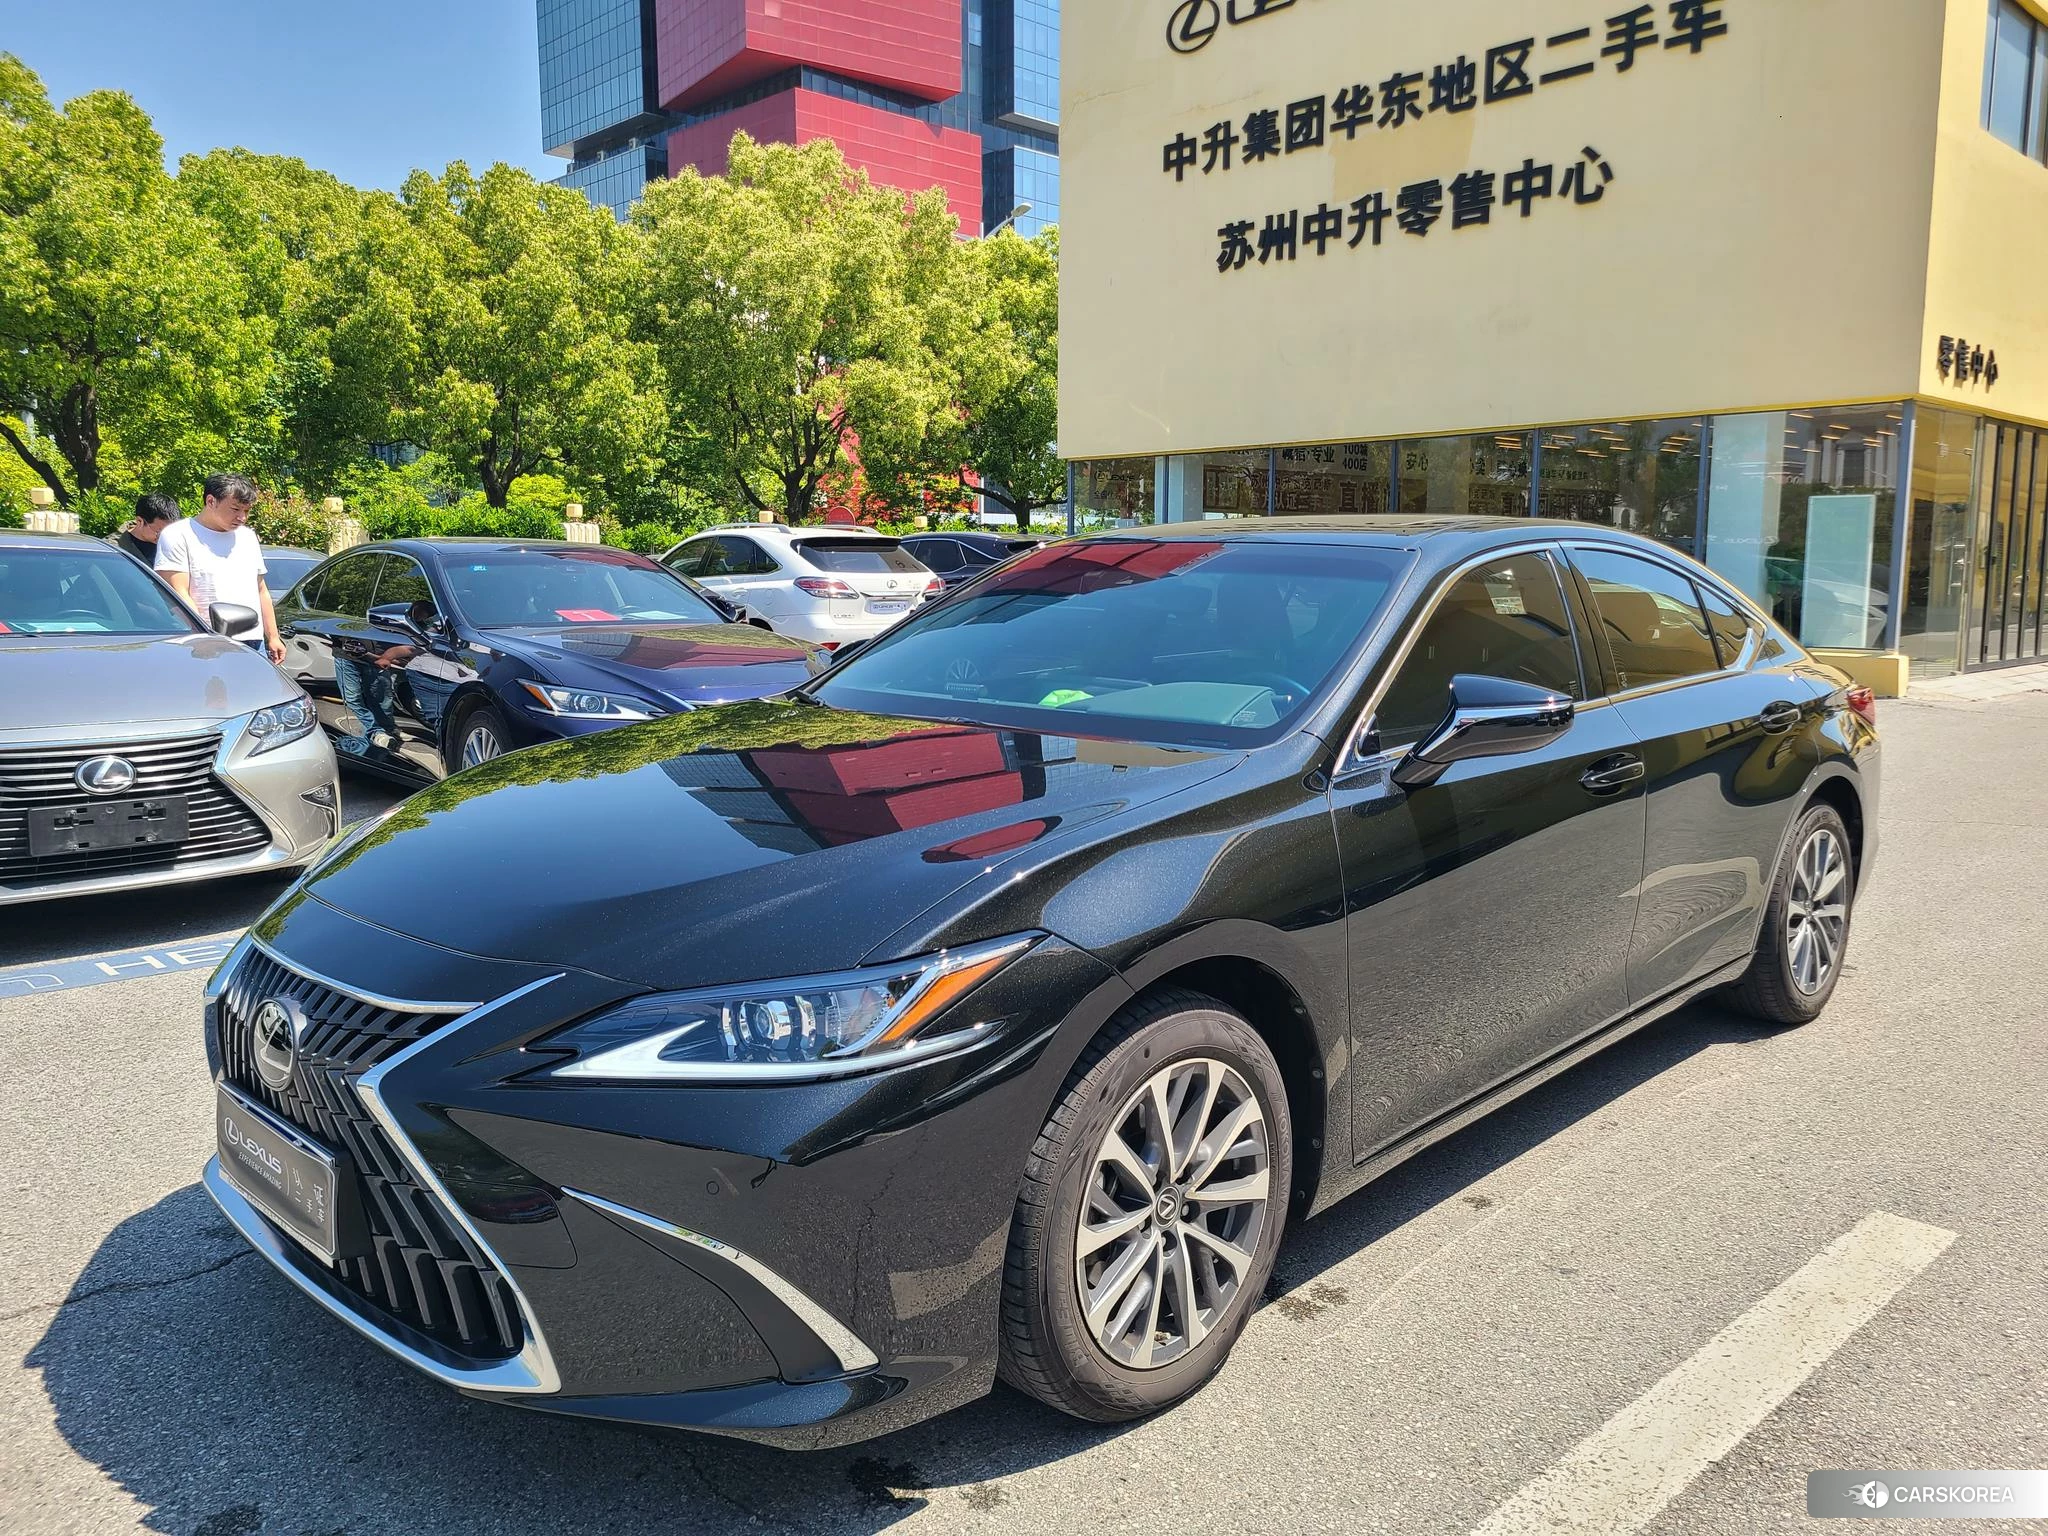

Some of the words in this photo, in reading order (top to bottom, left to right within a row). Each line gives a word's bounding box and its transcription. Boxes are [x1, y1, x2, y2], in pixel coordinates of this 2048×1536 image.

[1162, 0, 1728, 182] 中升集团华东地区二手车
[1216, 146, 1614, 273] 苏州中升零售中心
[1938, 335, 1999, 386] 零售中心
[94, 937, 241, 976] HE
[238, 1151, 263, 1175] EXPERIENCE
[262, 1170, 282, 1190] AMAZING
[240, 1131, 282, 1174] LEXUS
